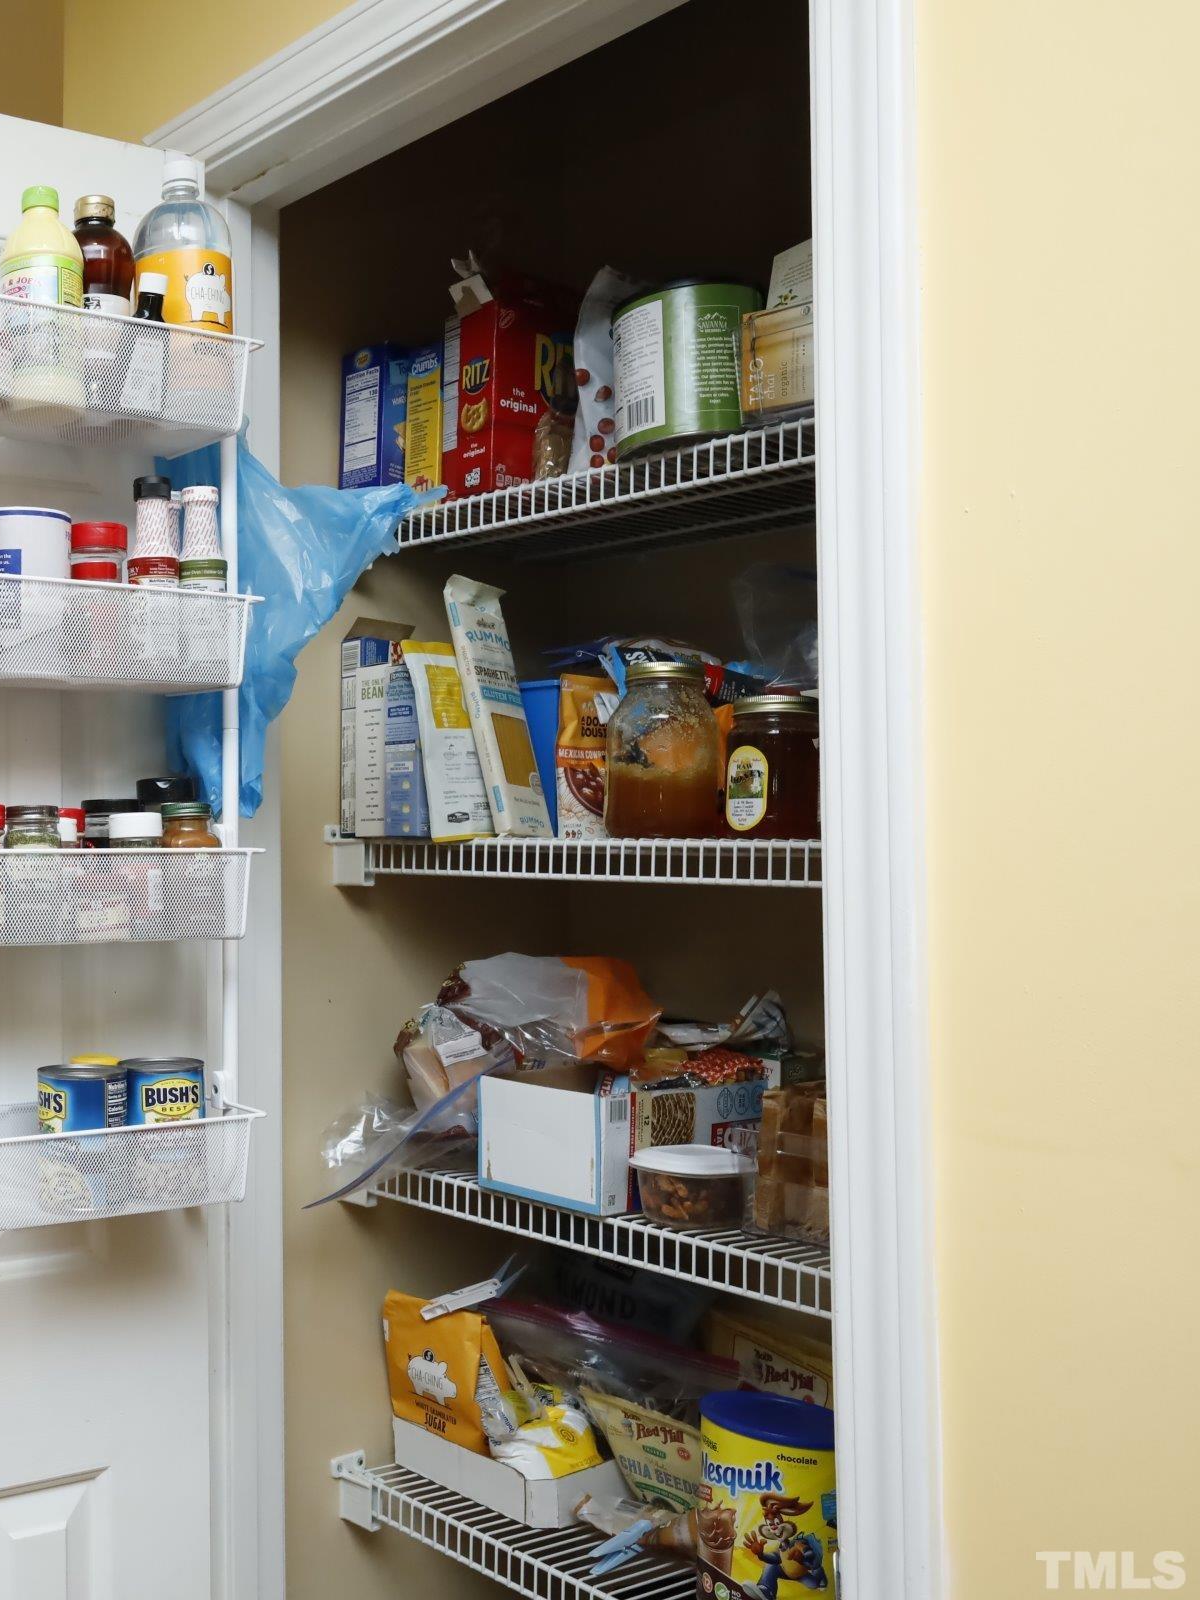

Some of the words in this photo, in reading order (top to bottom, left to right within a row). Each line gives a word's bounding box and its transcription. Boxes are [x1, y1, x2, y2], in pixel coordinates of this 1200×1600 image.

[697, 320, 728, 330] SAVANNA
[412, 357, 439, 376] Crumbs
[462, 358, 490, 390] RITZ
[749, 358, 764, 405] TAZO
[765, 374, 776, 400] chai
[780, 361, 789, 397] organic
[512, 387, 526, 398] the
[500, 397, 537, 414] original
[463, 446, 486, 459] original
[474, 665, 509, 682] SPAGHETTI
[361, 686, 384, 700] BEAN
[483, 688, 507, 700] GLUTEN
[581, 726, 607, 738] COUSI
[558, 748, 585, 758] MEXICAN
[731, 770, 763, 784] HONEY
[39, 1090, 63, 1114] SH'S
[144, 1084, 199, 1108] BUSH'S
[161, 1105, 187, 1113] BEST
[644, 1115, 650, 1126] 12
[411, 1366, 443, 1390] CHA-CHING
[764, 1364, 789, 1384] Red
[789, 1370, 815, 1392] Mill
[424, 1413, 447, 1434] SUGAR
[429, 1405, 457, 1425] GRANULATED
[636, 1422, 660, 1440] Red
[660, 1426, 685, 1445] Mill
[619, 1455, 652, 1480] CHIA
[776, 1453, 818, 1466] chocolate
